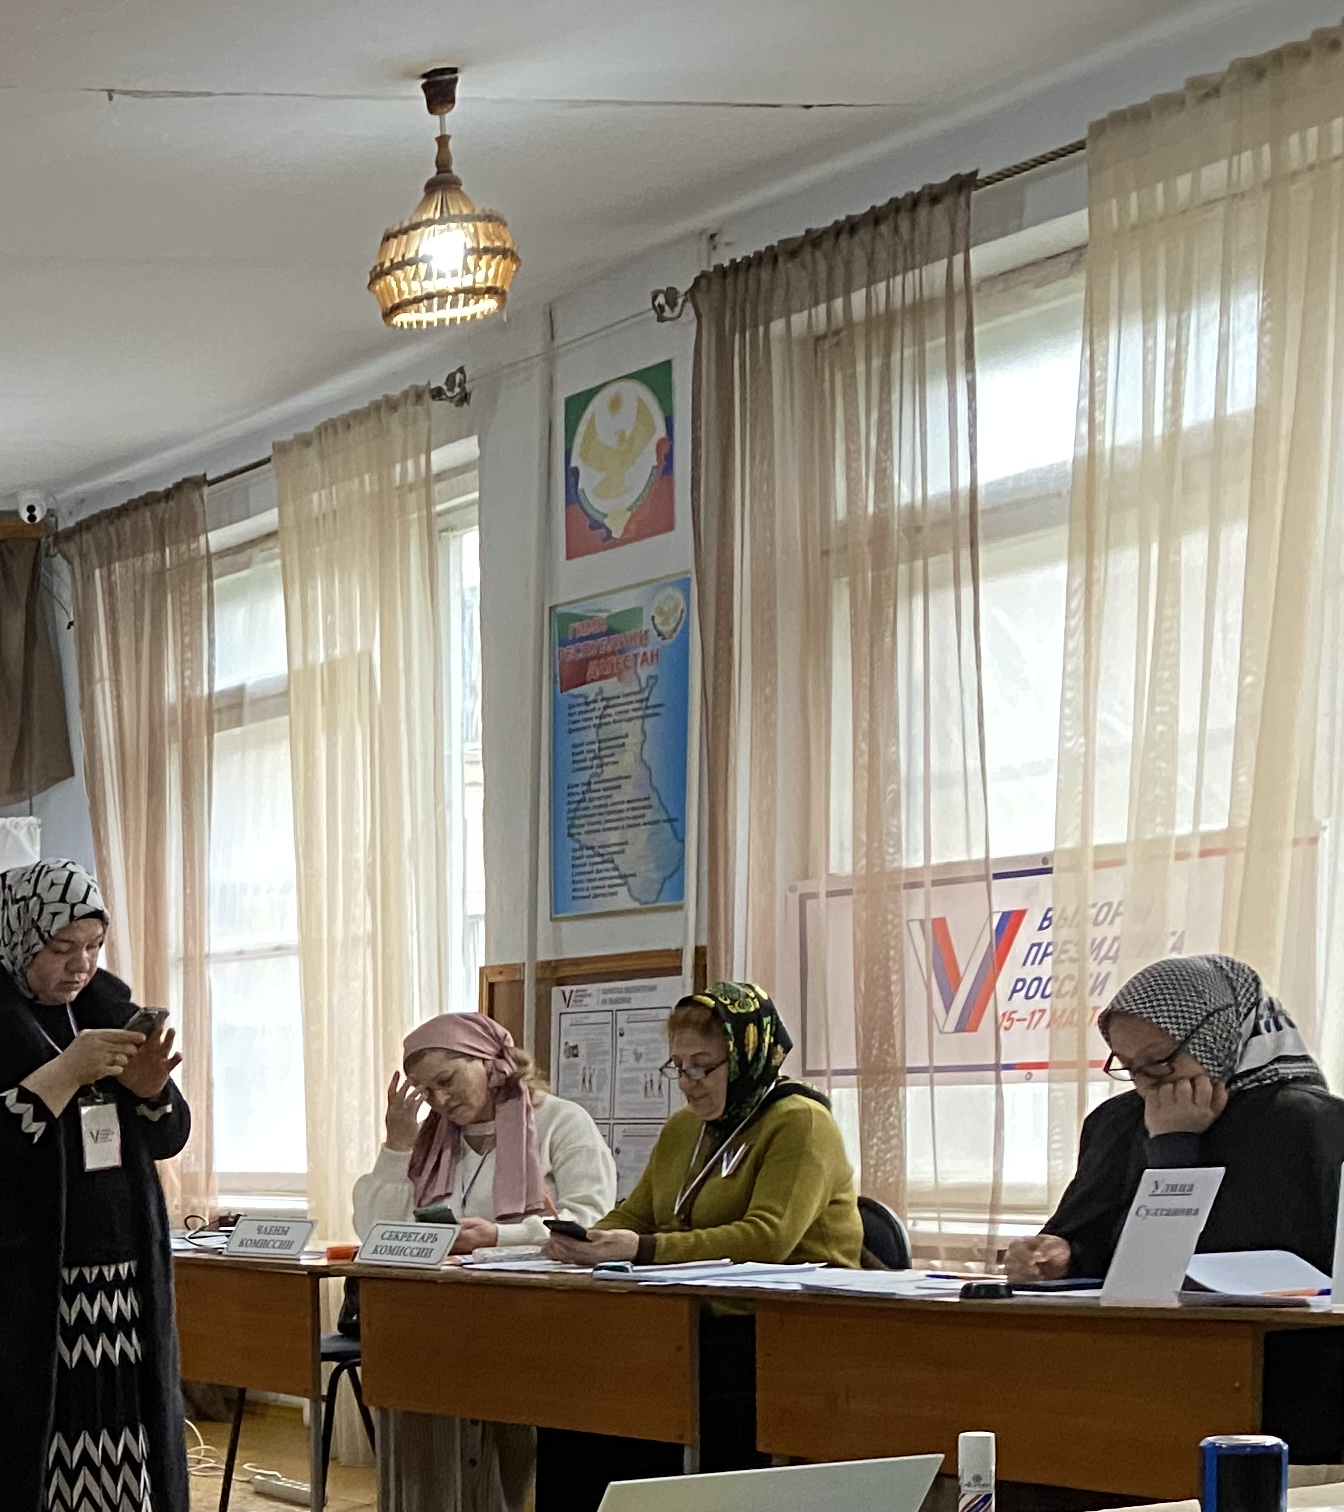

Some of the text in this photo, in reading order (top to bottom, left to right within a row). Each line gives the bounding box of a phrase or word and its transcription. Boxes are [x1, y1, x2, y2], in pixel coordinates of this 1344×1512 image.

[256, 1225, 291, 1236] ЧЛЕНЫ
[381, 1229, 439, 1244] СЕКРЕТАРЬ
[238, 1238, 295, 1251] КОМИССИИ
[372, 1243, 434, 1259] КОМИССИИ
